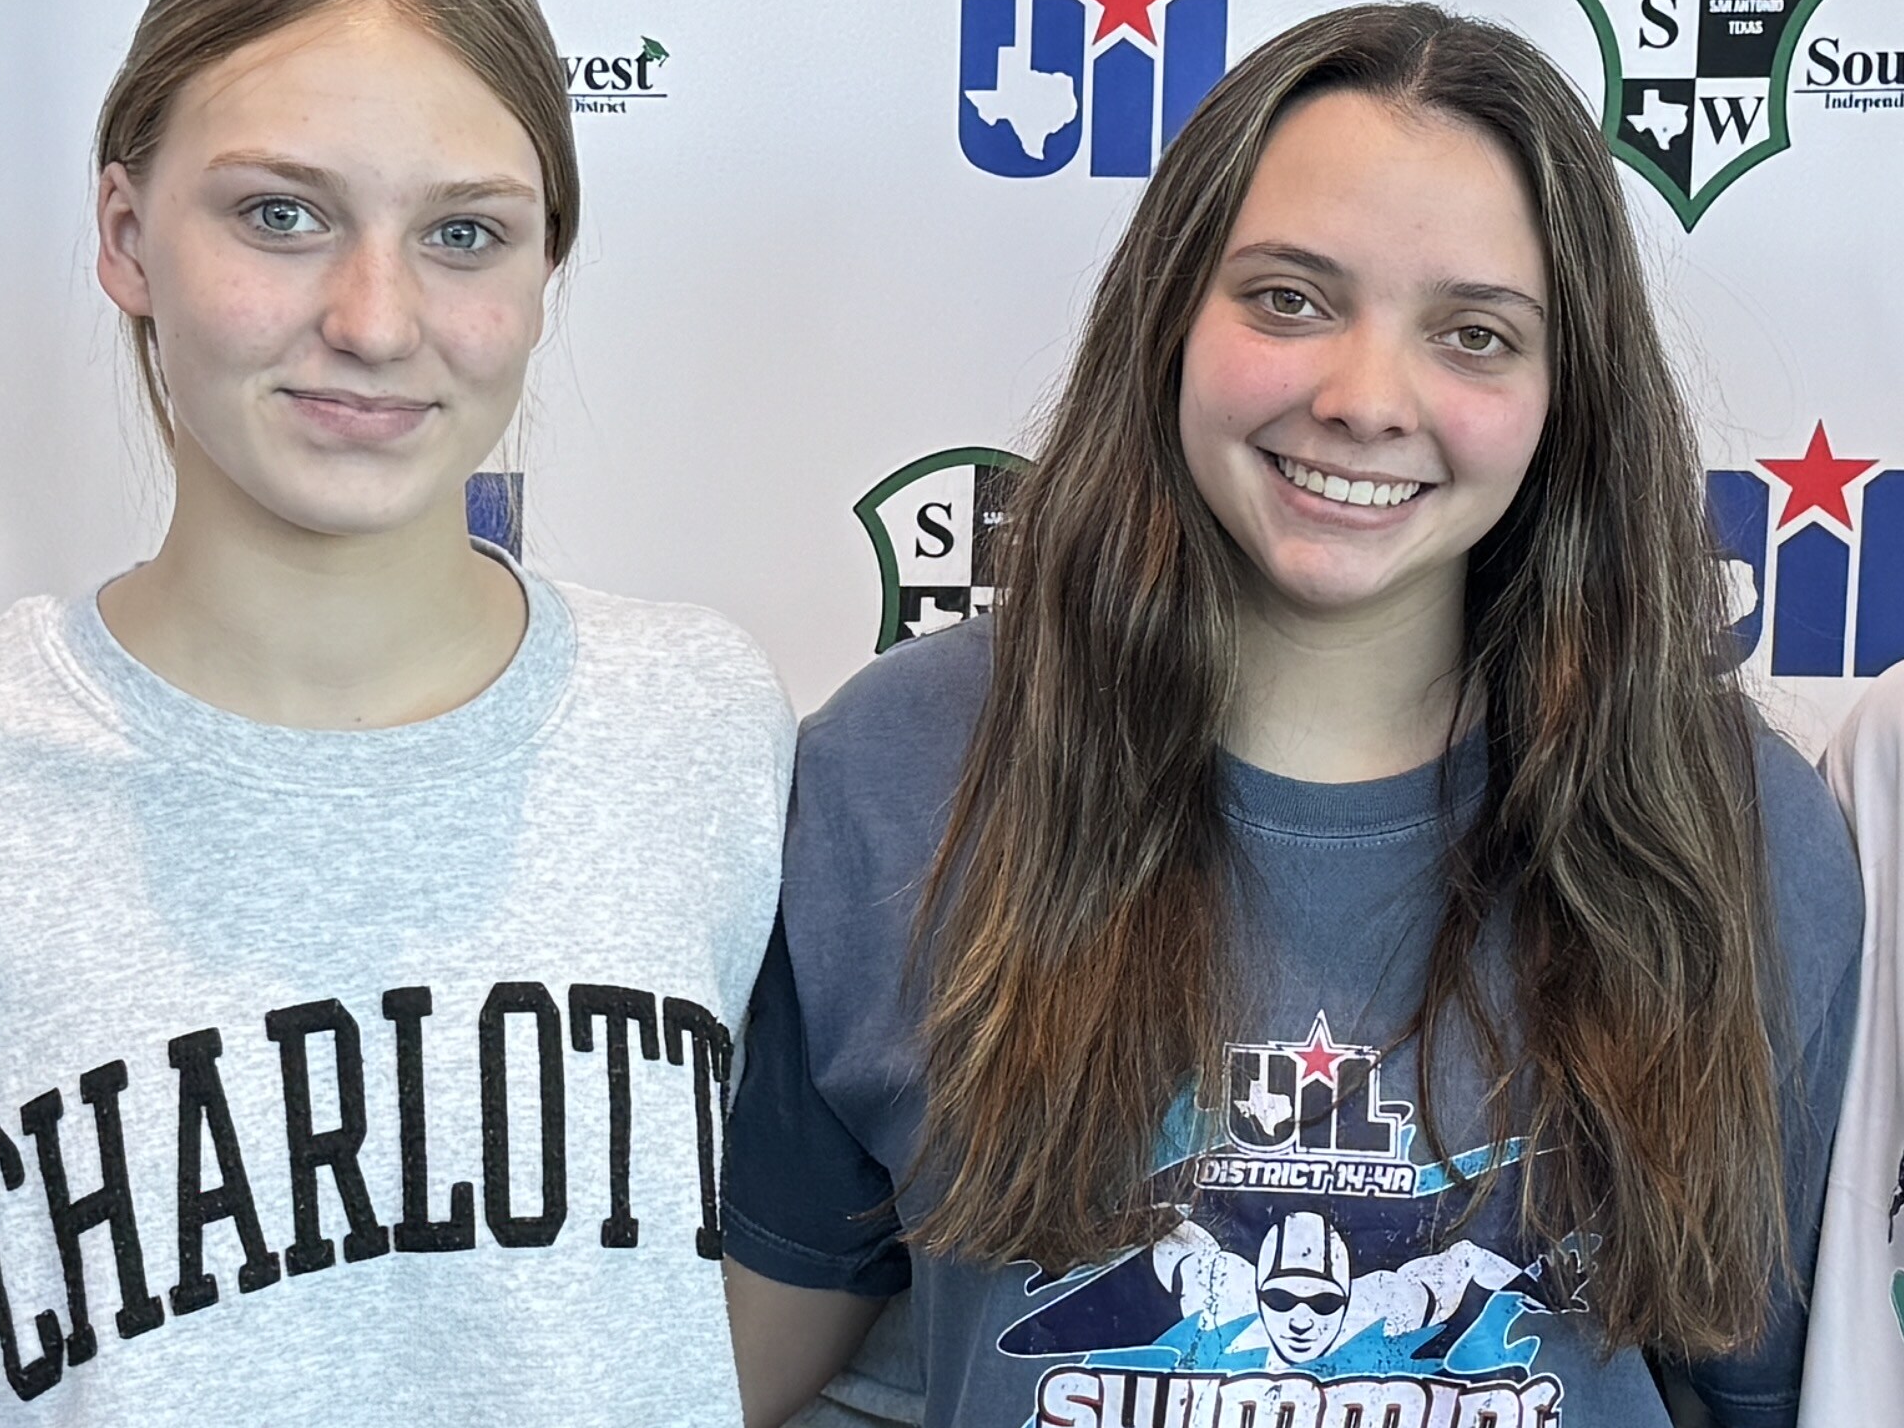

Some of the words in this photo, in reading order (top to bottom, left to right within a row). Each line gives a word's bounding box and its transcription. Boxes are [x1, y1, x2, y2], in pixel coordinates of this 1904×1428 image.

[1700, 96, 1764, 144] W
[914, 502, 954, 559] S
[1199, 1159, 1329, 1189] DISTRICT
